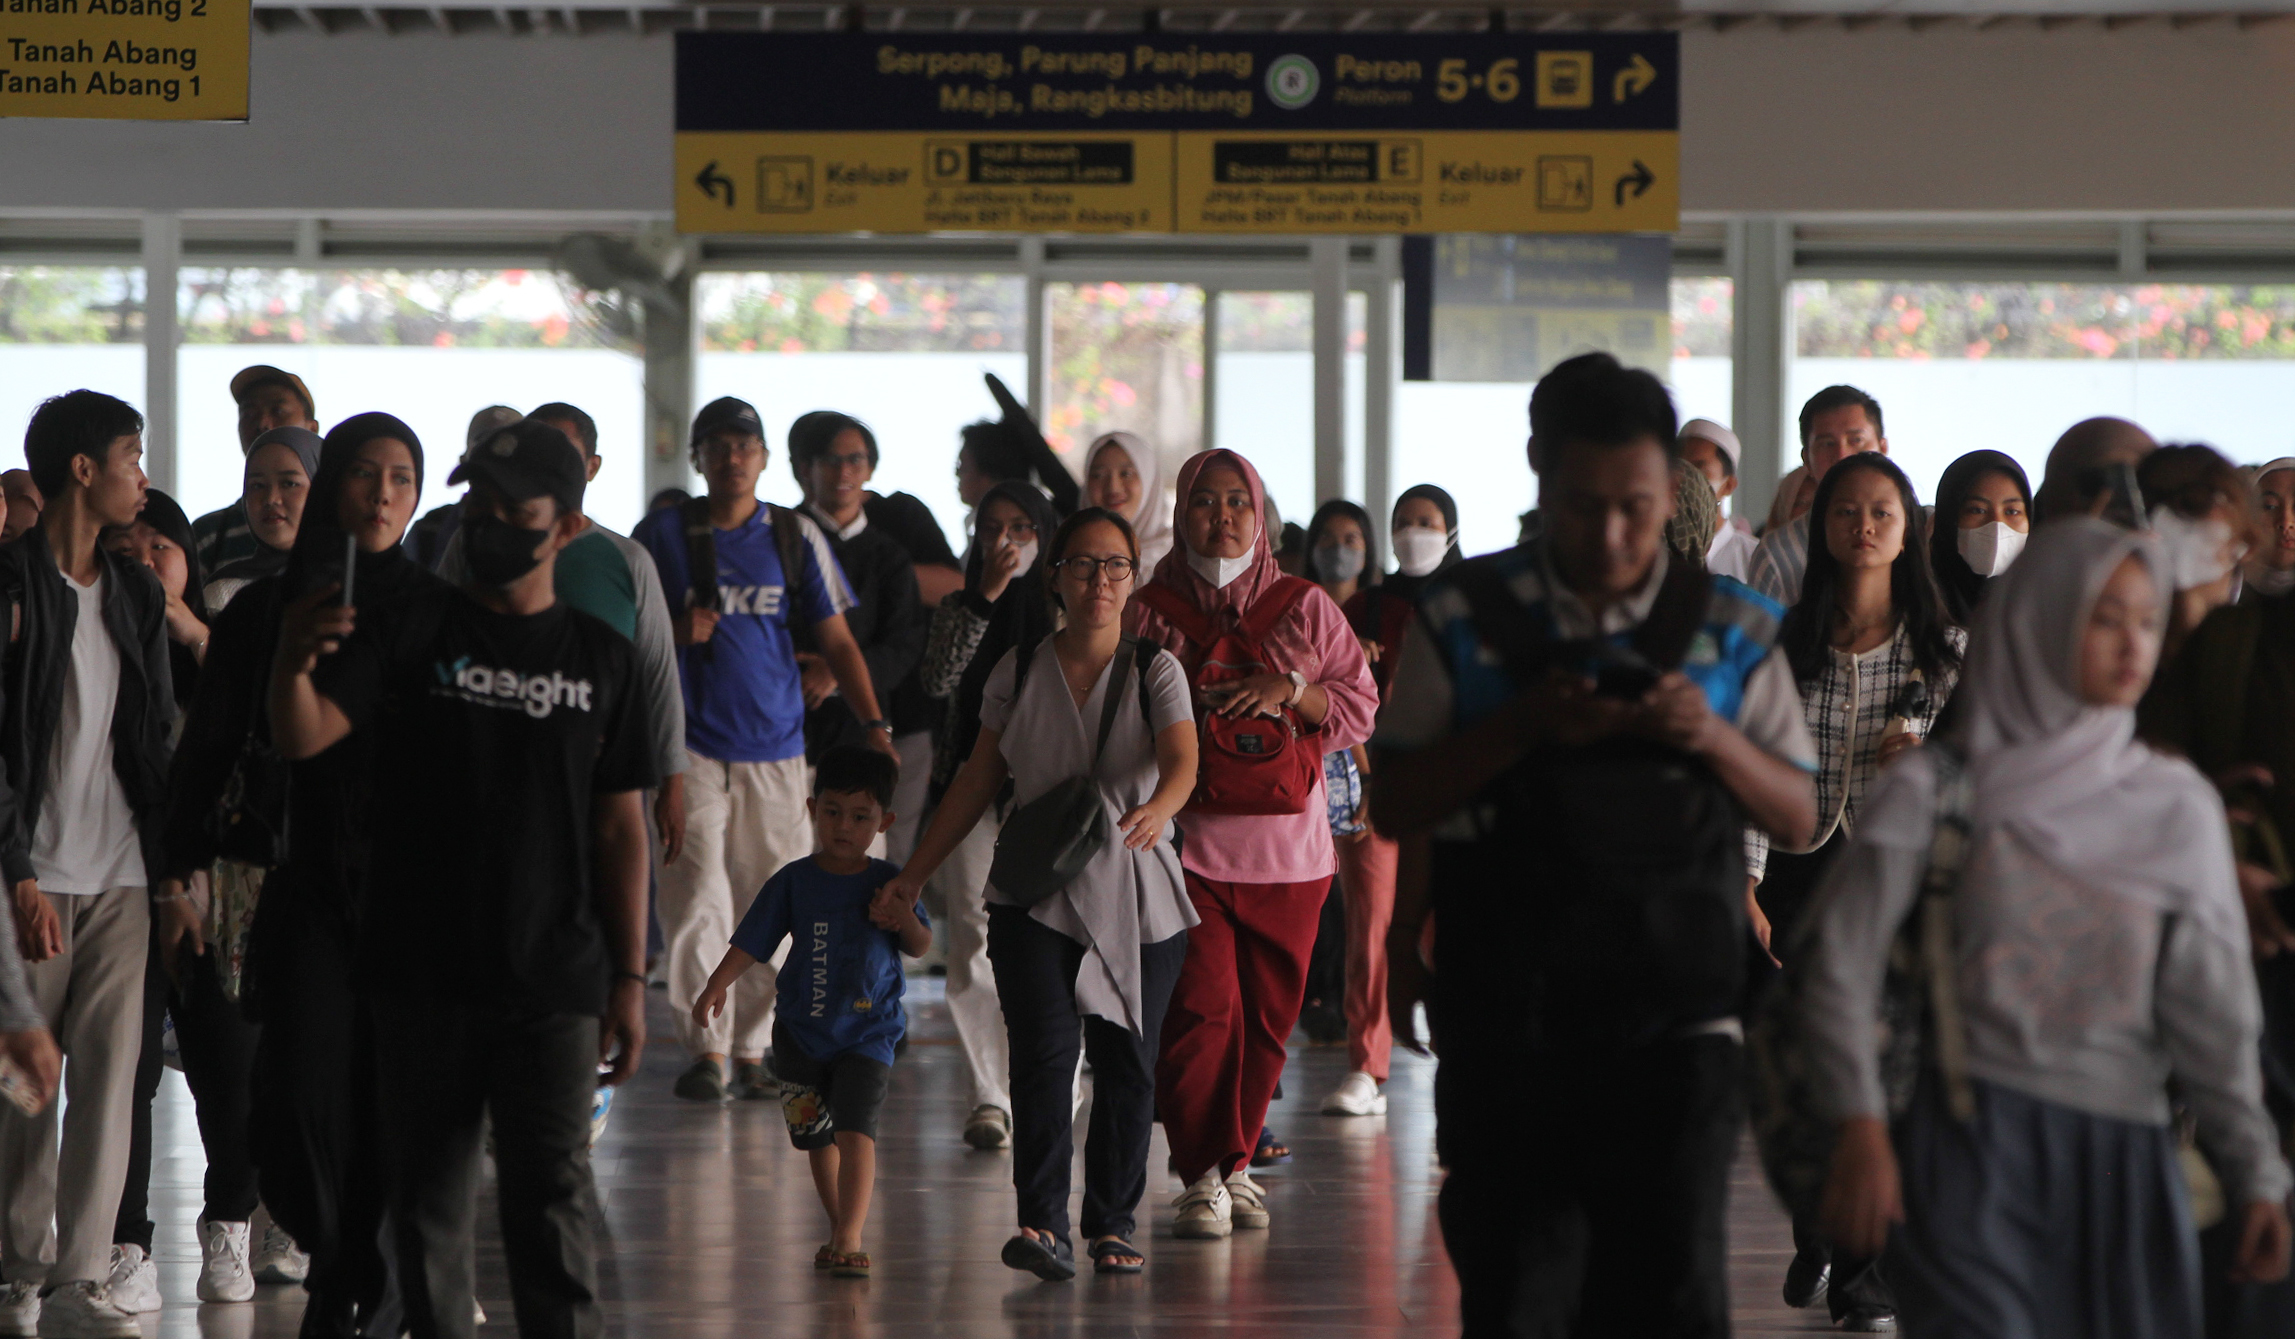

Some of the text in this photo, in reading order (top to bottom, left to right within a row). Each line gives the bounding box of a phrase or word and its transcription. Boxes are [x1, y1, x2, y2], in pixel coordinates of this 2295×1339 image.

[0, 0, 207, 22] anah Abang 2
[7, 38, 197, 71] Tanah Abang
[877, 45, 1253, 80] Serpong, Parung Panjang
[1334, 53, 1422, 82] Peron
[85, 71, 180, 102] Abang
[189, 75, 200, 96] 1
[939, 83, 1253, 118] Maja, Rangkasbitung
[826, 162, 911, 185] Keluar
[934, 148, 961, 178] D
[1390, 149, 1409, 176] E
[1440, 161, 1524, 185] Keluar
[809, 922, 829, 1018] BATMAN
